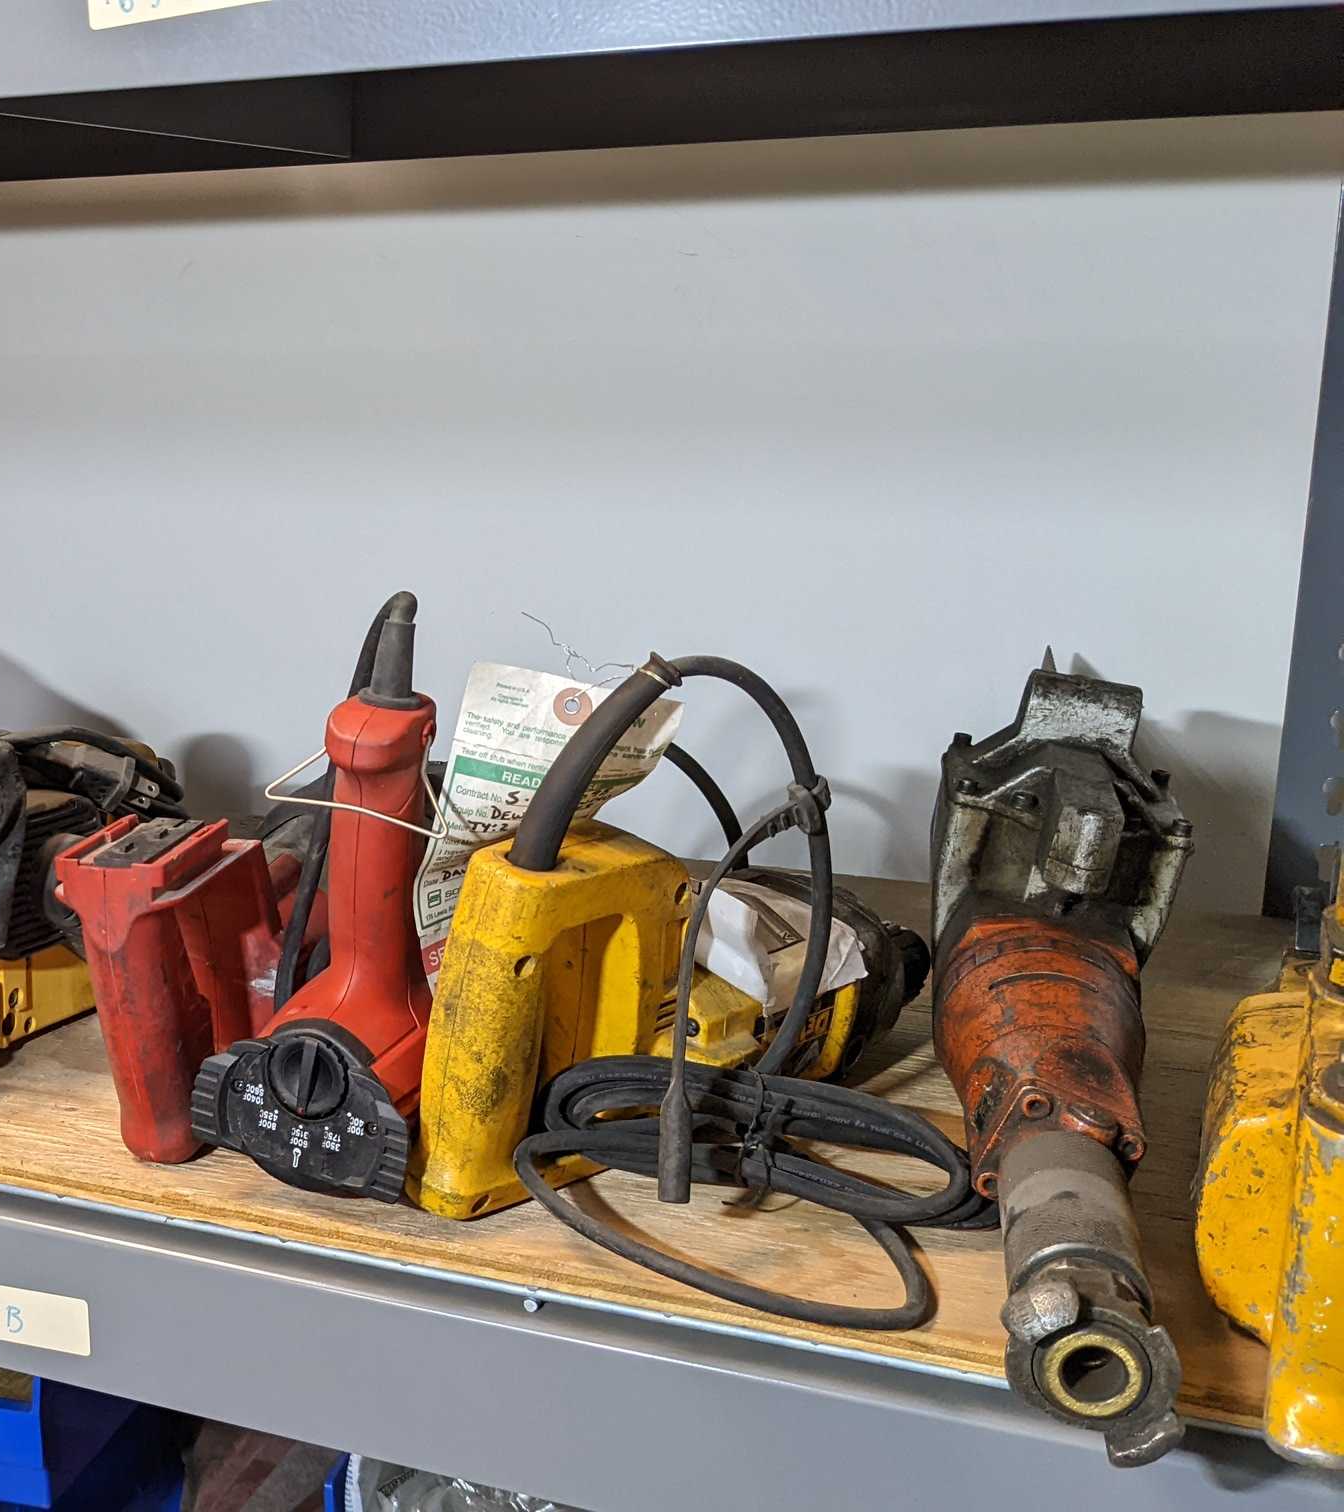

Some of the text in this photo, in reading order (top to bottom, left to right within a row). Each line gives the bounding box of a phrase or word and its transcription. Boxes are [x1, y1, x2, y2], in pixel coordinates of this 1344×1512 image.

[502, 726, 515, 737] You
[518, 732, 530, 740] are
[507, 721, 520, 730] and
[522, 724, 567, 741] performance
[479, 750, 488, 759] off
[502, 771, 542, 789] READ
[455, 785, 489, 800] Contract
[452, 804, 474, 816] Equip
[490, 805, 524, 821] DEW
[242, 1093, 264, 1106] 1040F
[259, 1109, 279, 1122] 425C
[349, 1116, 365, 1128] 40C
[258, 1118, 277, 1131] 800F
[346, 1125, 365, 1137] 100F
[291, 1127, 310, 1140] 315C
[323, 1130, 342, 1143] 175C
[289, 1136, 309, 1149] 600F
[321, 1140, 342, 1152] 350F
